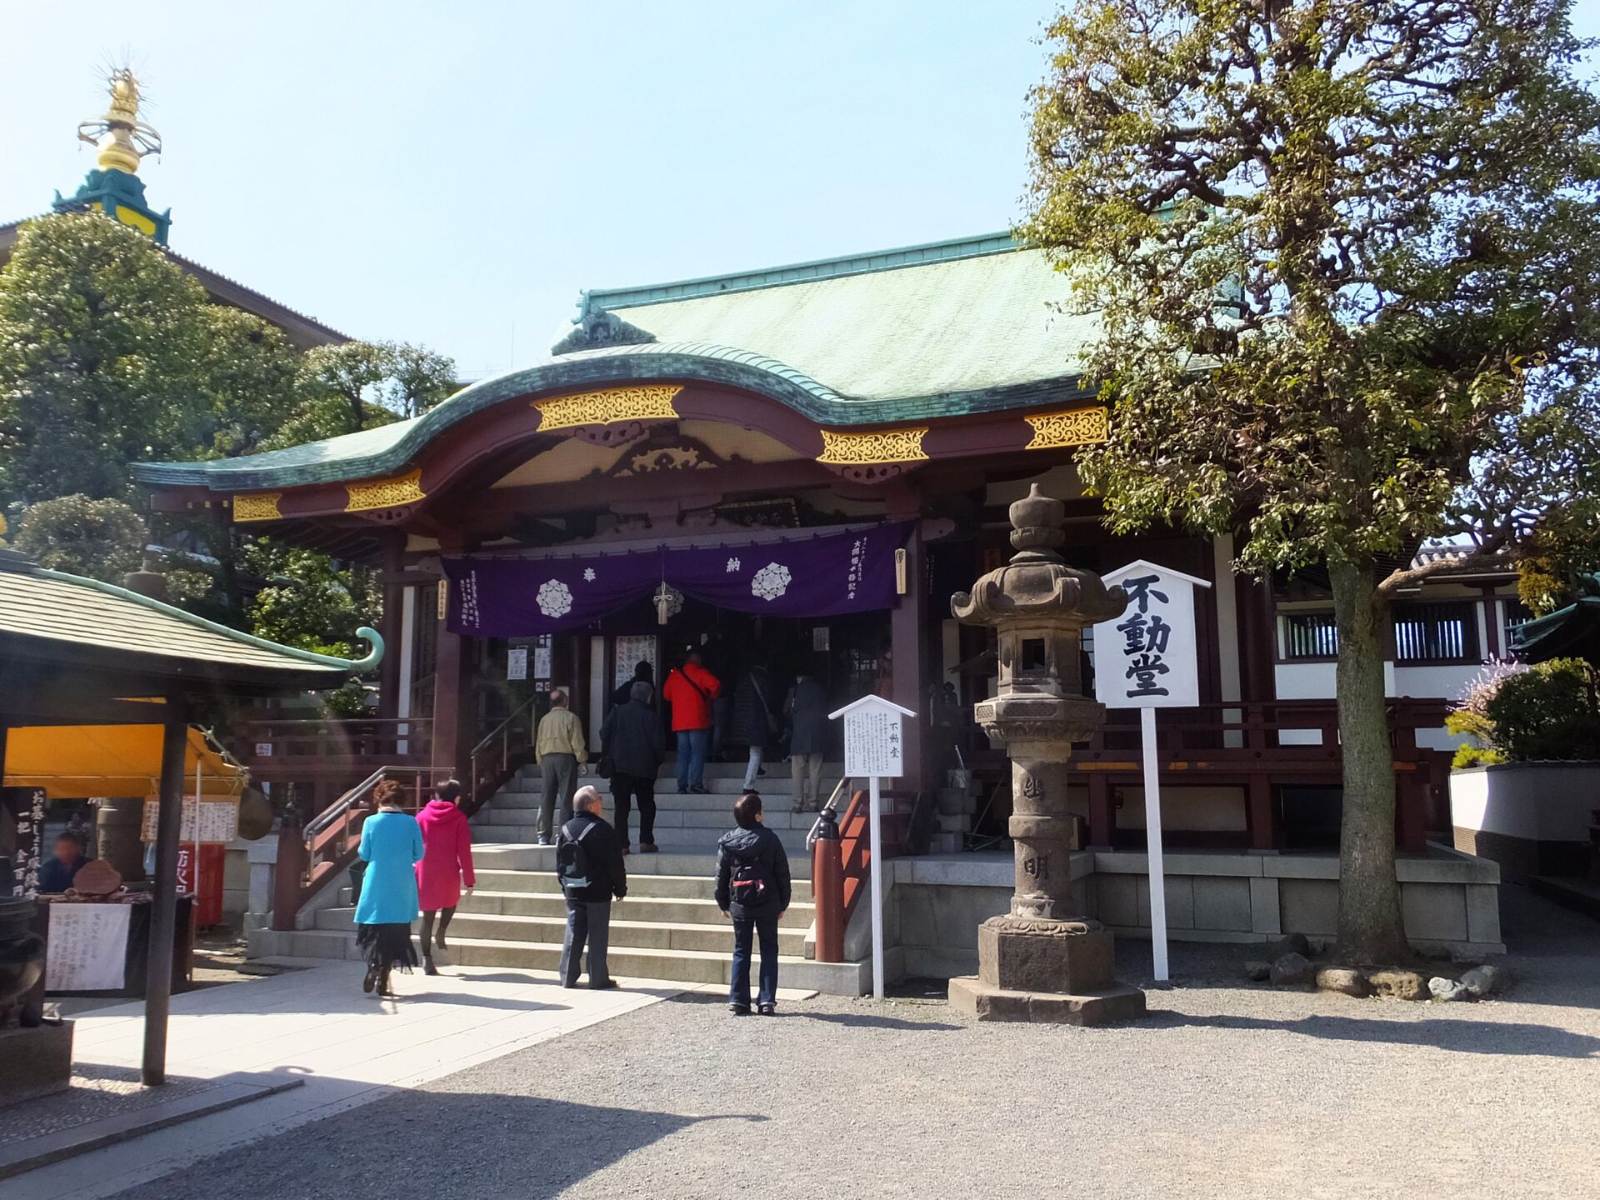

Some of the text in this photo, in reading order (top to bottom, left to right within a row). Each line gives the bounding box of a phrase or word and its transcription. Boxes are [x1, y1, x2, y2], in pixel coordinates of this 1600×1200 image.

[583, 556, 741, 583] 奉 納
[1116, 574, 1172, 698] 不動堂
[888, 722, 900, 759] 不動堂
